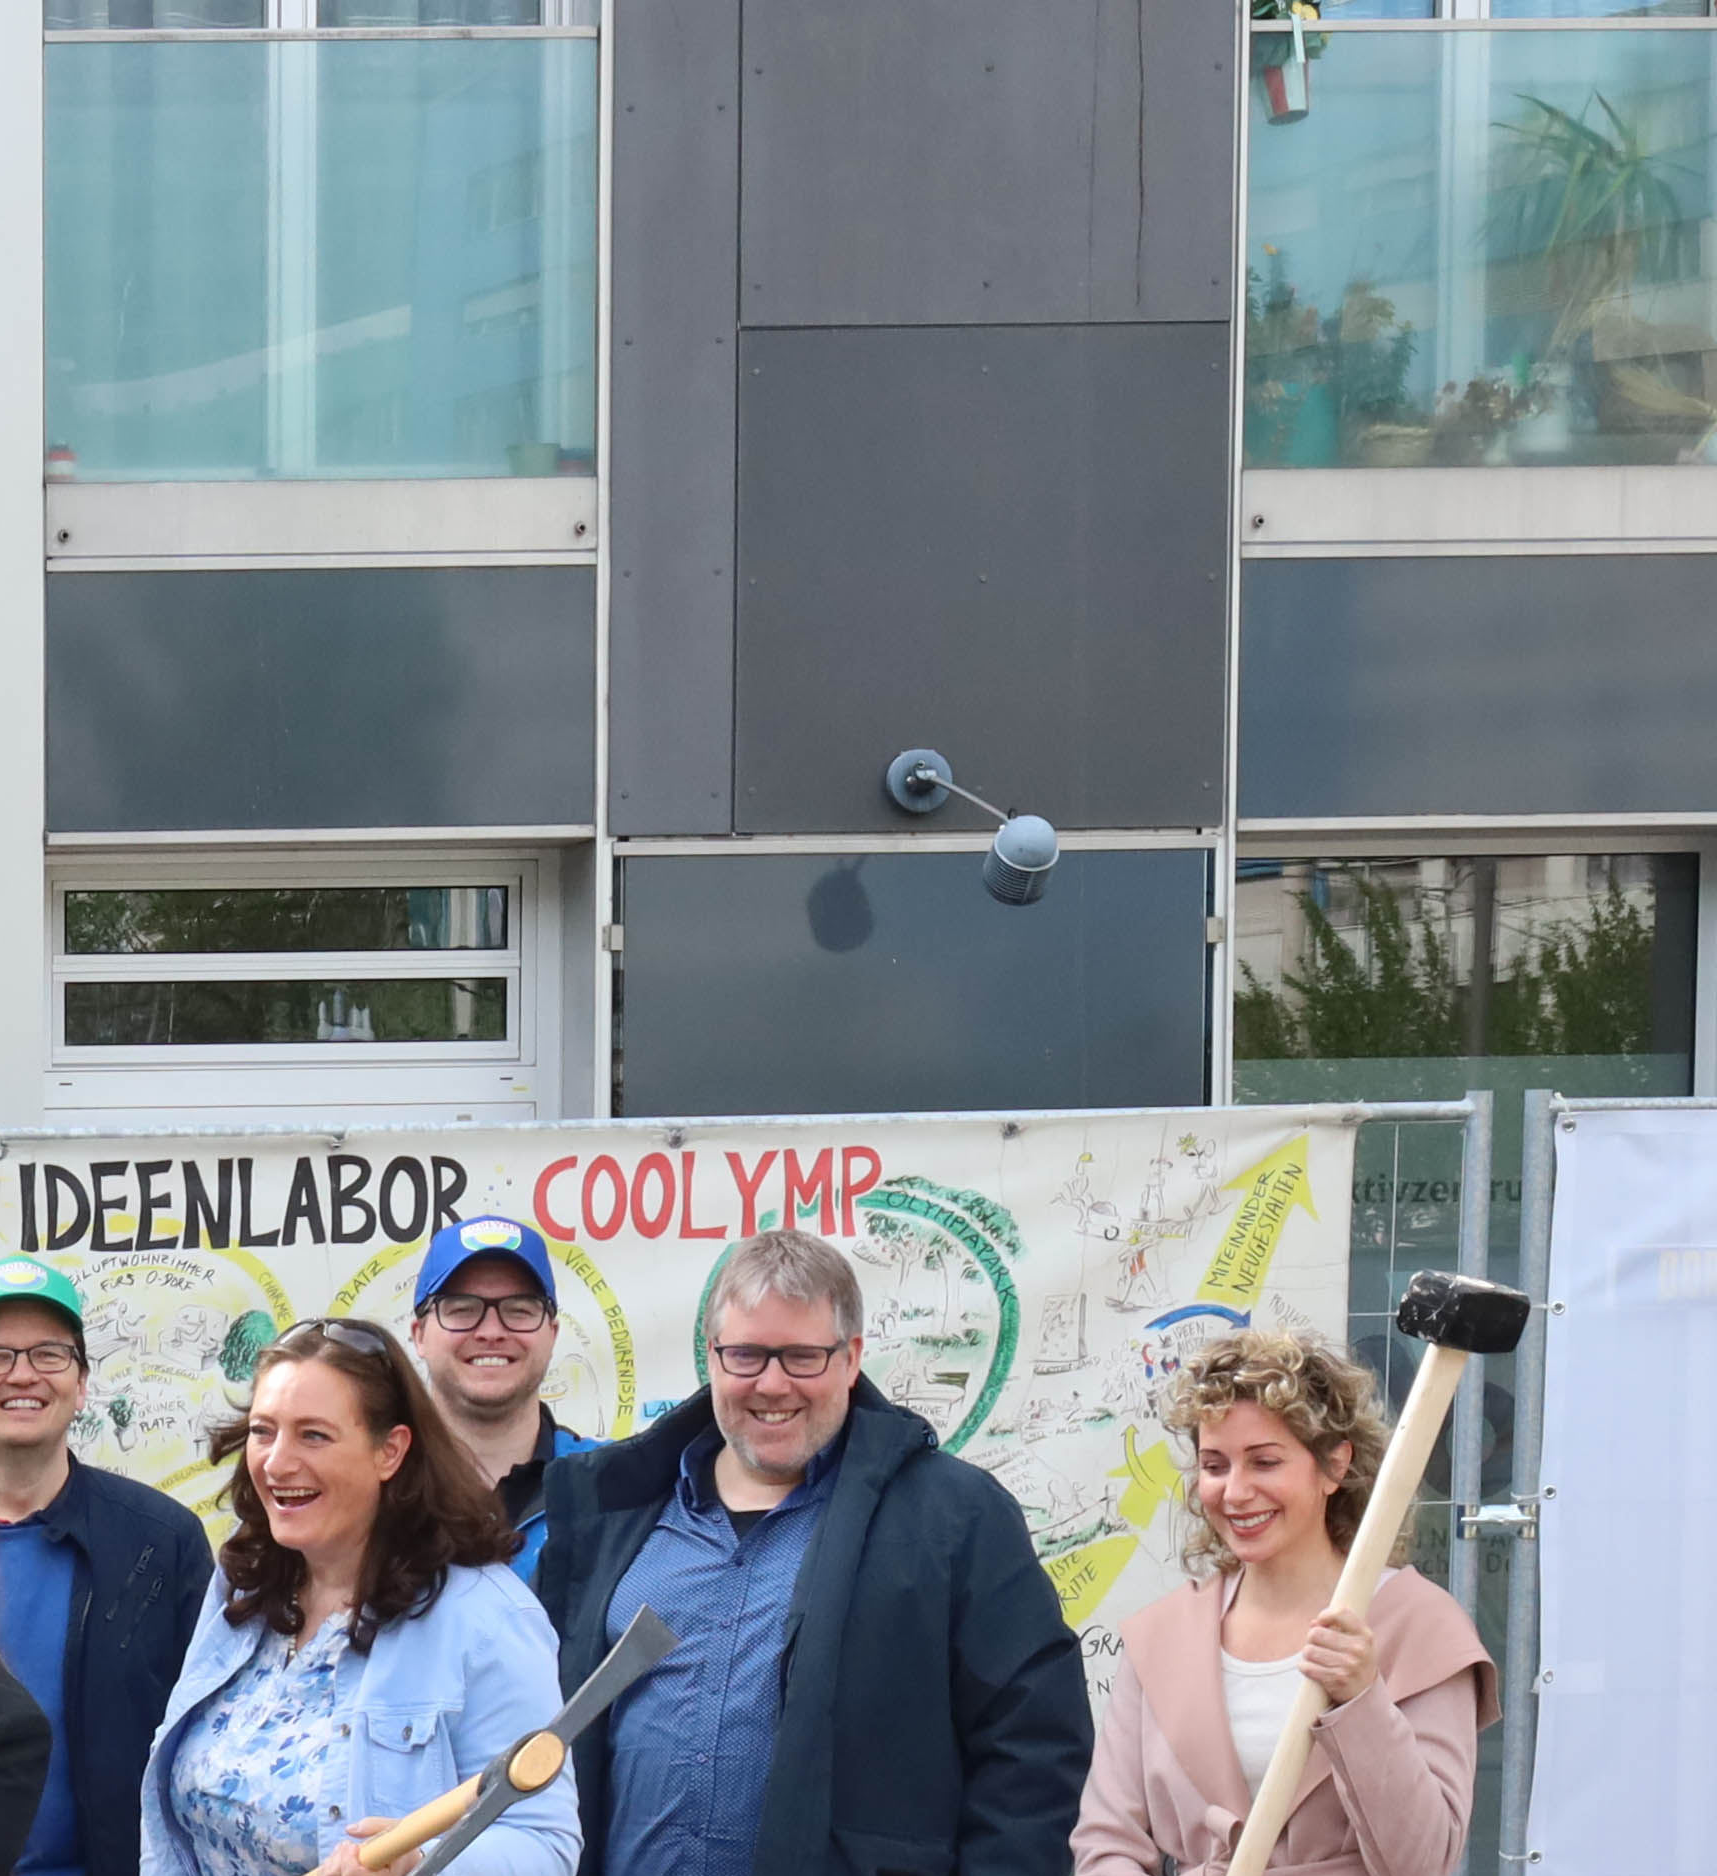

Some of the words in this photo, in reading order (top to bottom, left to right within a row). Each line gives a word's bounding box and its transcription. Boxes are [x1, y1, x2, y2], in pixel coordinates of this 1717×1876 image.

[19, 1154, 468, 1253] IDEENLABOR
[533, 1145, 883, 1241] COOLYMP
[1205, 1168, 1276, 1288] MITEINANDER
[335, 1258, 385, 1308] PLATZ
[565, 1249, 608, 1295] VIELE
[885, 1190, 1020, 1308] OLYMPIAPARK
[258, 1271, 294, 1323] CHARME
